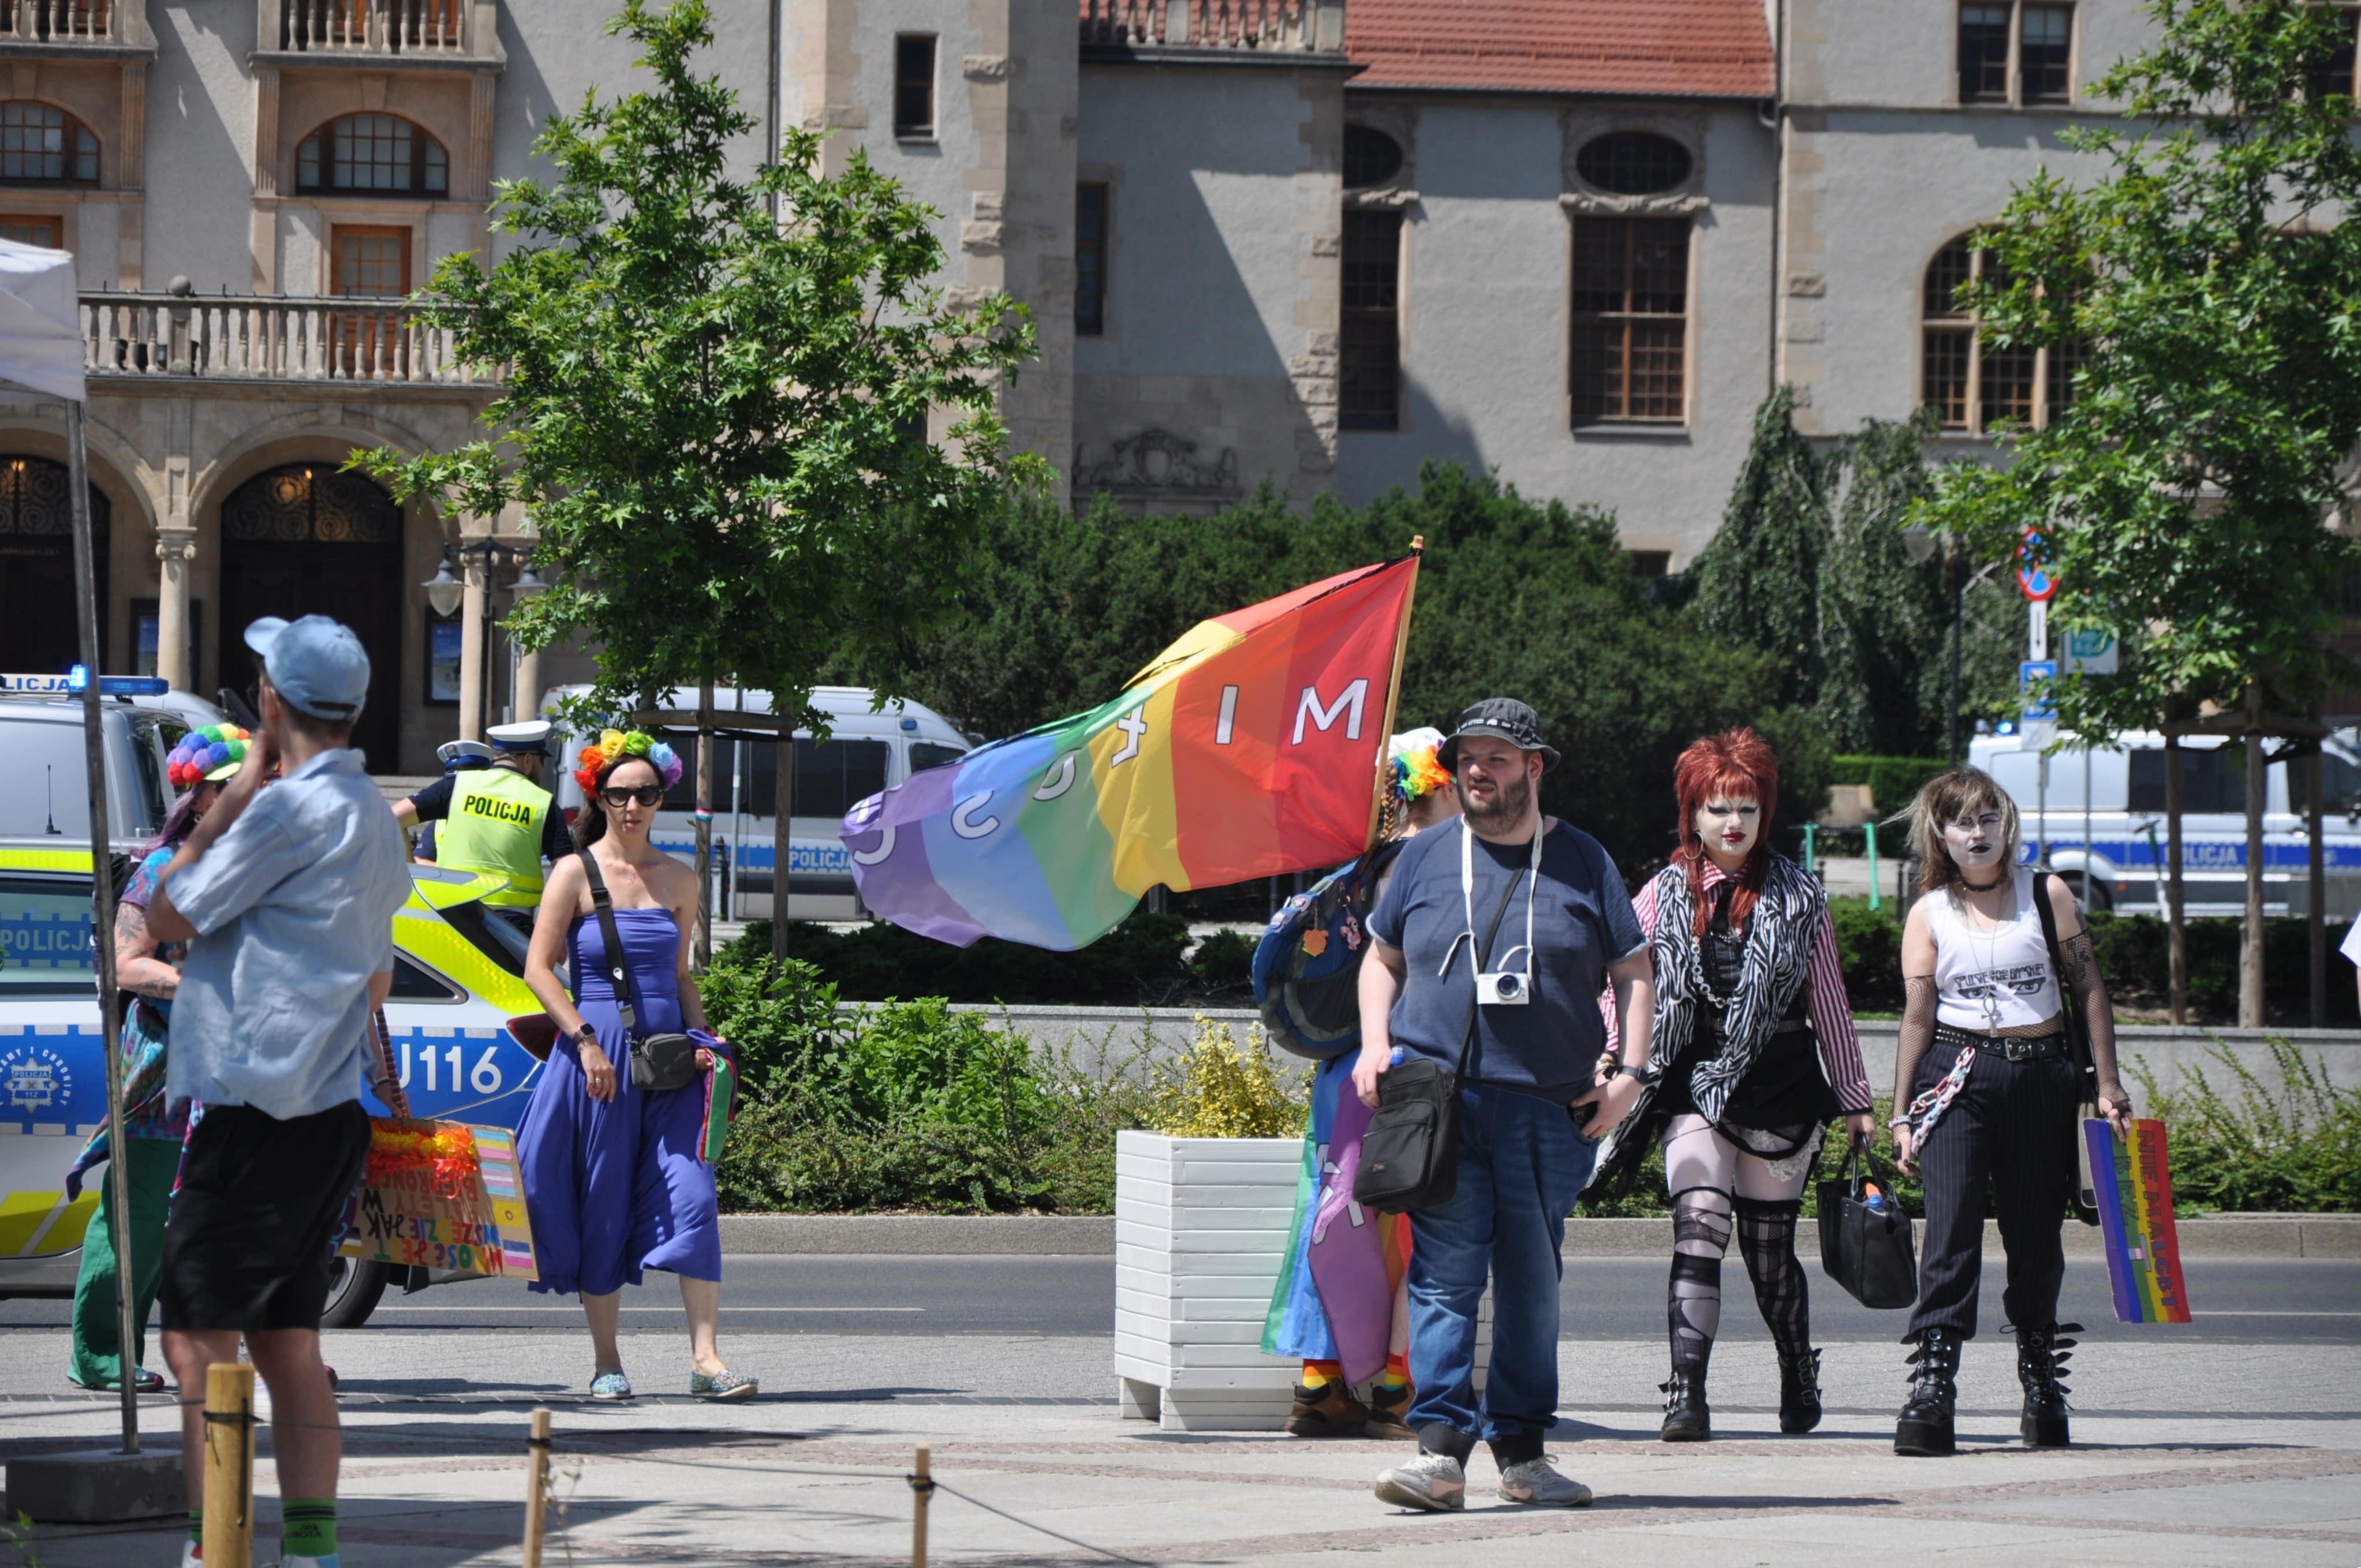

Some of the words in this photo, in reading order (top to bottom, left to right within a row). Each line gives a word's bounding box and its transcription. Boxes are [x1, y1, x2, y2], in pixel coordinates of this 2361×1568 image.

[464, 795, 530, 824] POLICJA
[2164, 845, 2237, 863] LICJA
[2137, 1129, 2158, 1184] NIE
[361, 1188, 384, 1214] W
[2114, 1156, 2139, 1227] BEZ
[365, 1213, 405, 1240] JAK
